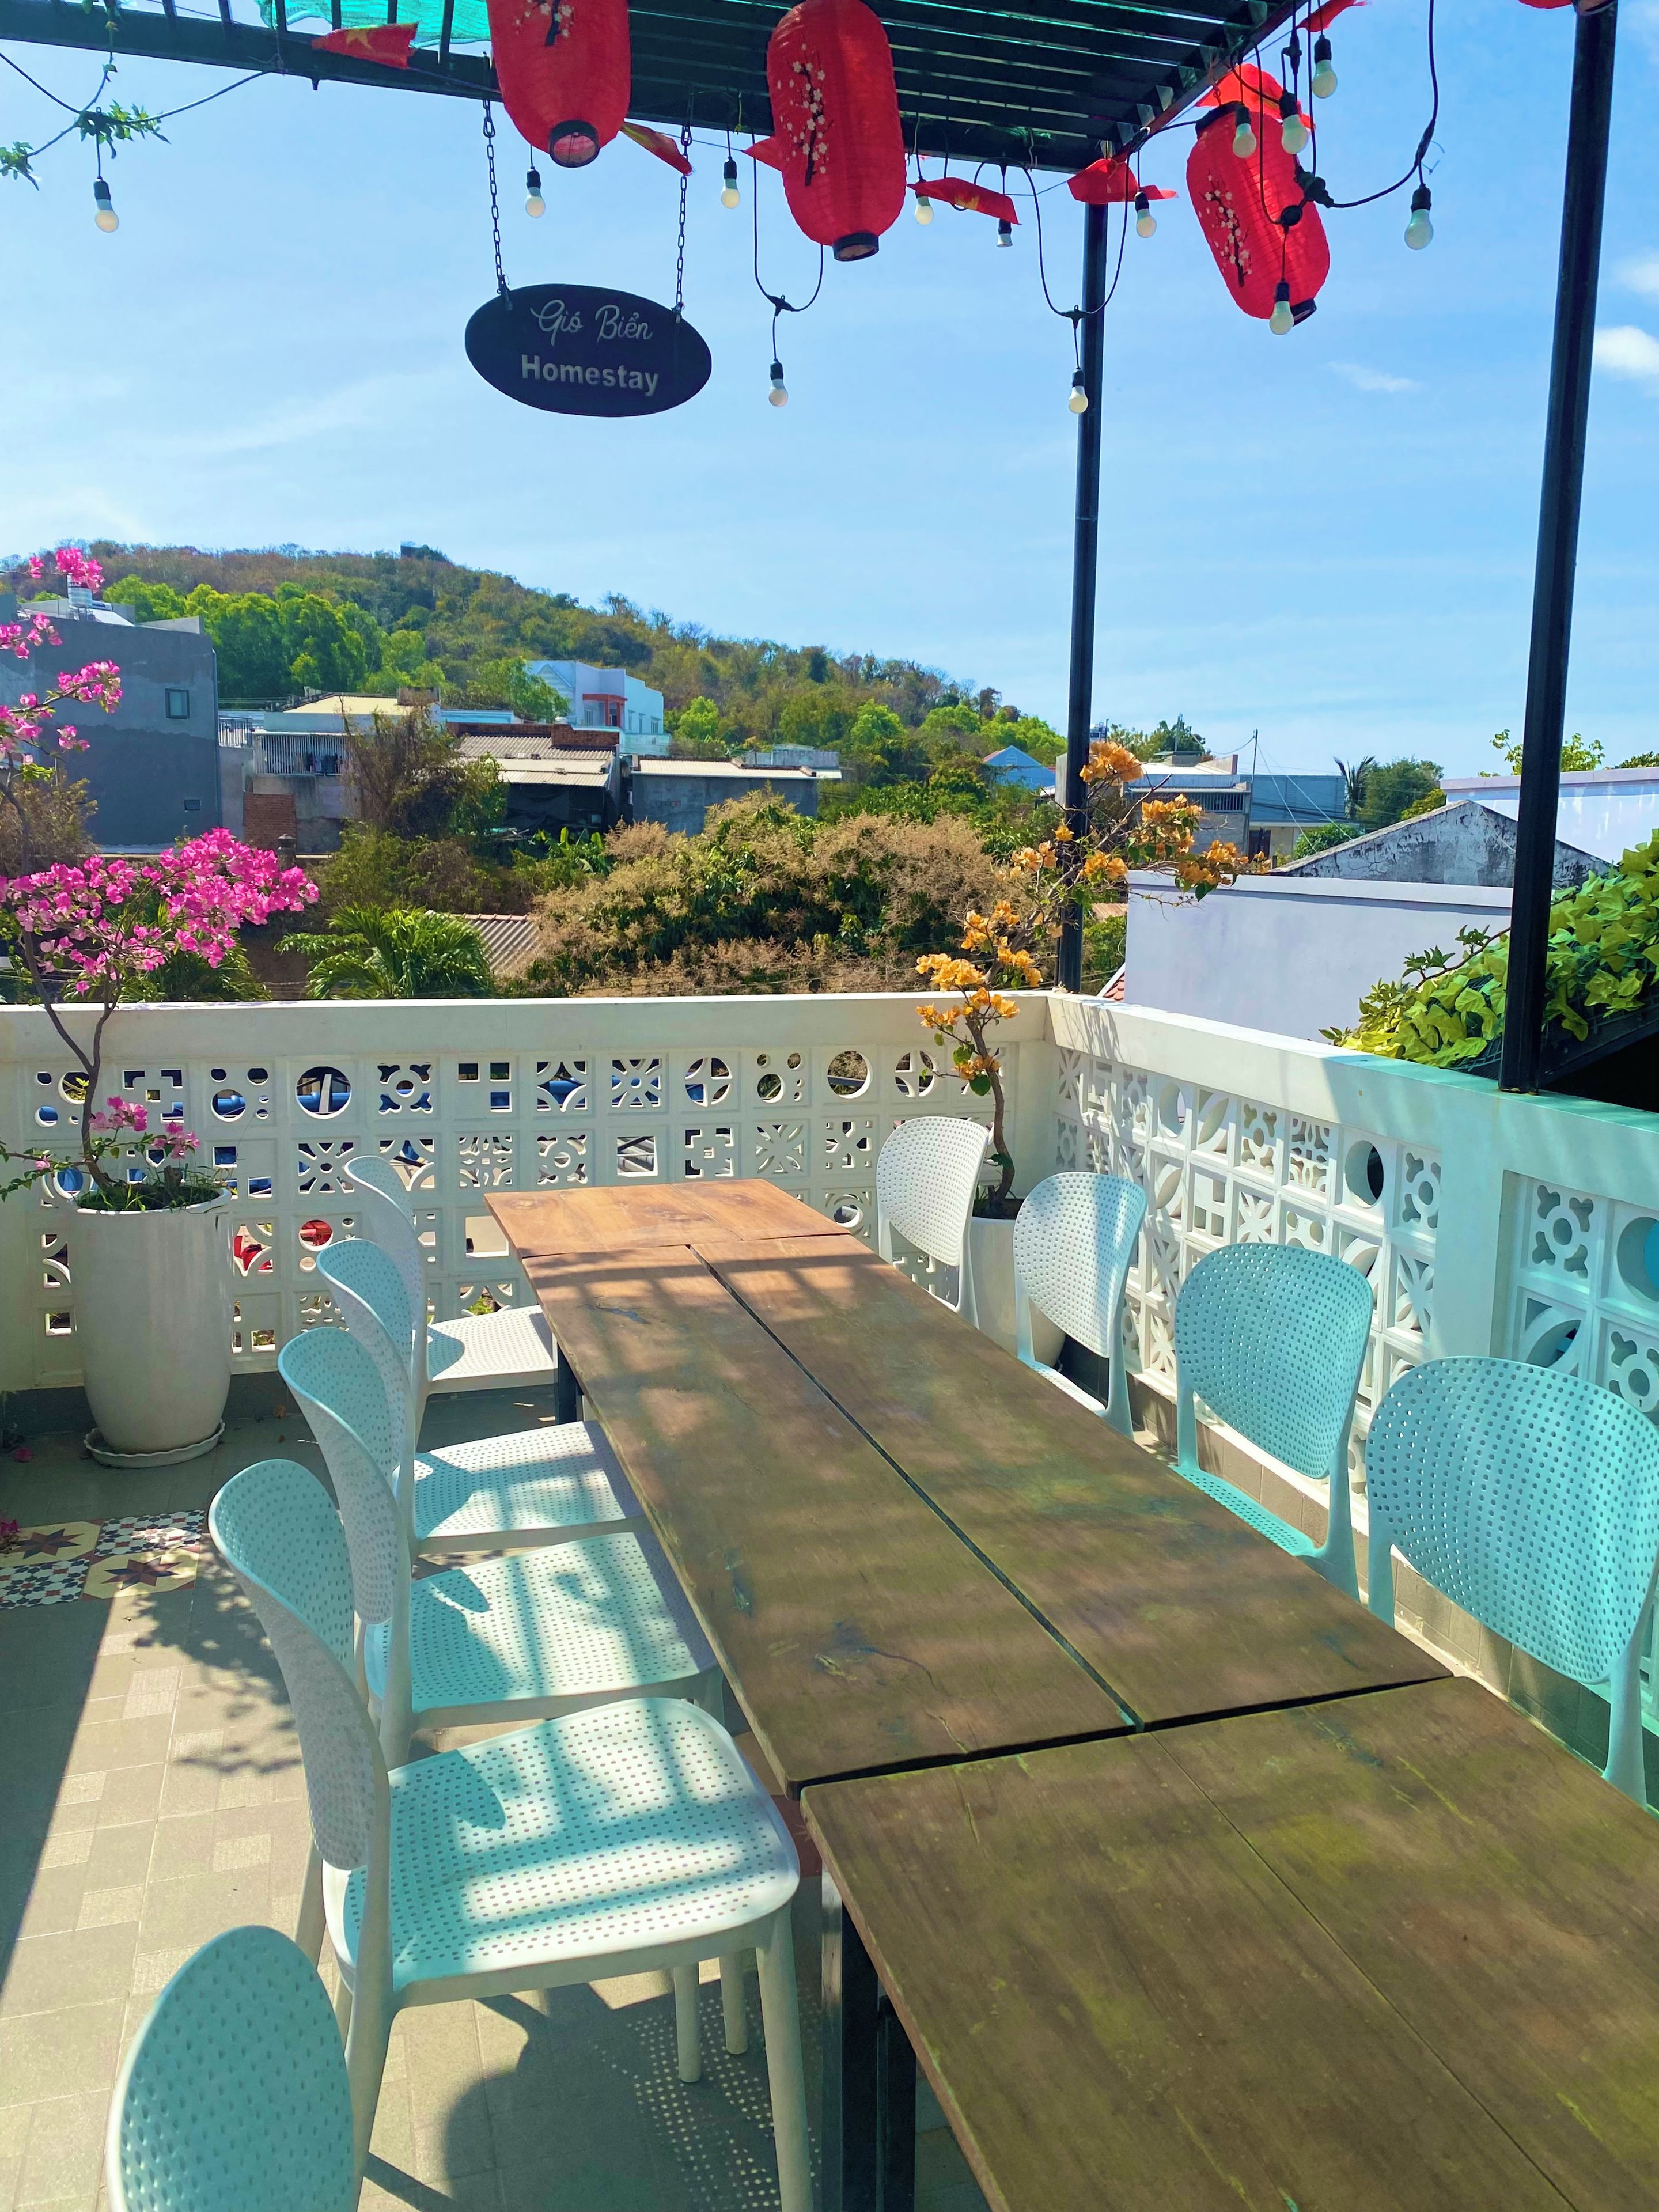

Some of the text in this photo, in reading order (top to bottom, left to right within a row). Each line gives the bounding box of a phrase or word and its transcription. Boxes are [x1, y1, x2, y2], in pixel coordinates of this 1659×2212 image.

[529, 299, 653, 346] Gió Biển
[521, 353, 659, 397] Homestay
